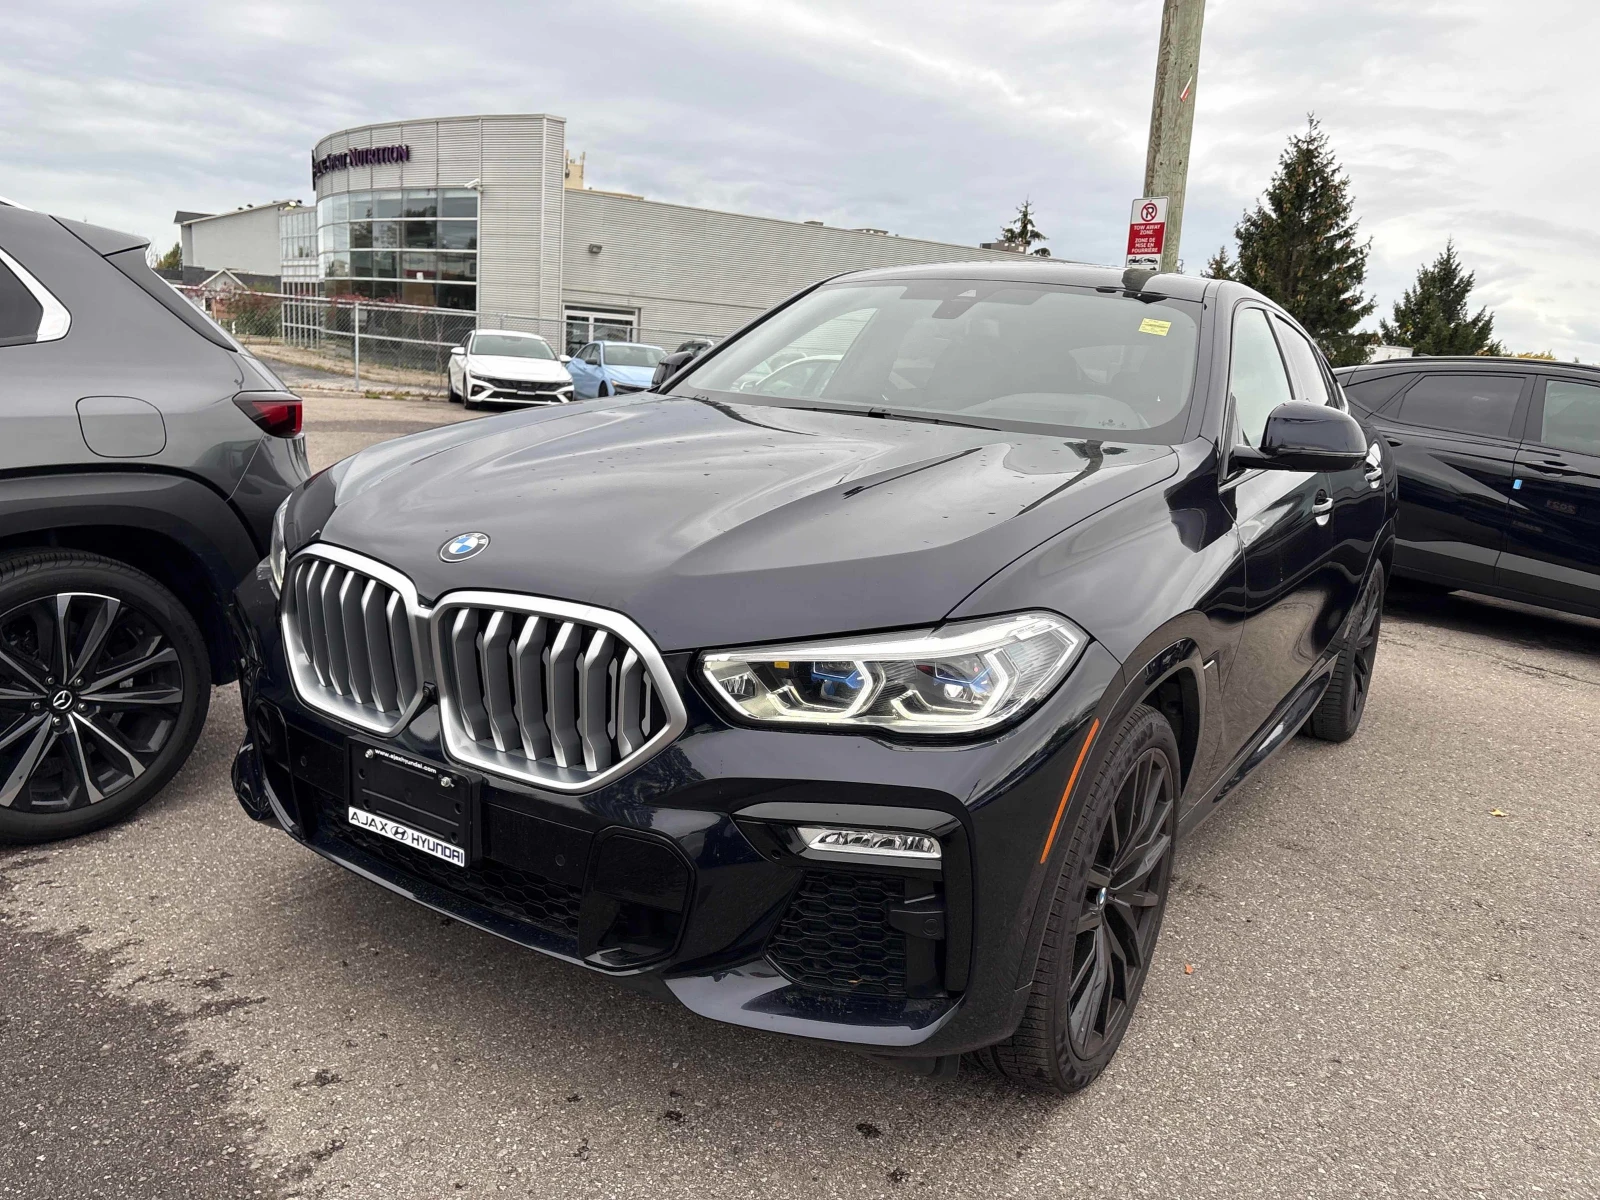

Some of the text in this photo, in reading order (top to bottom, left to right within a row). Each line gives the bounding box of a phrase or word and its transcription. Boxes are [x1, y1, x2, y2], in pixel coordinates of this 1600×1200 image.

[374, 748, 437, 774] www.ajaxhyundai.com
[350, 811, 464, 864] AJAX HYUNDAI
